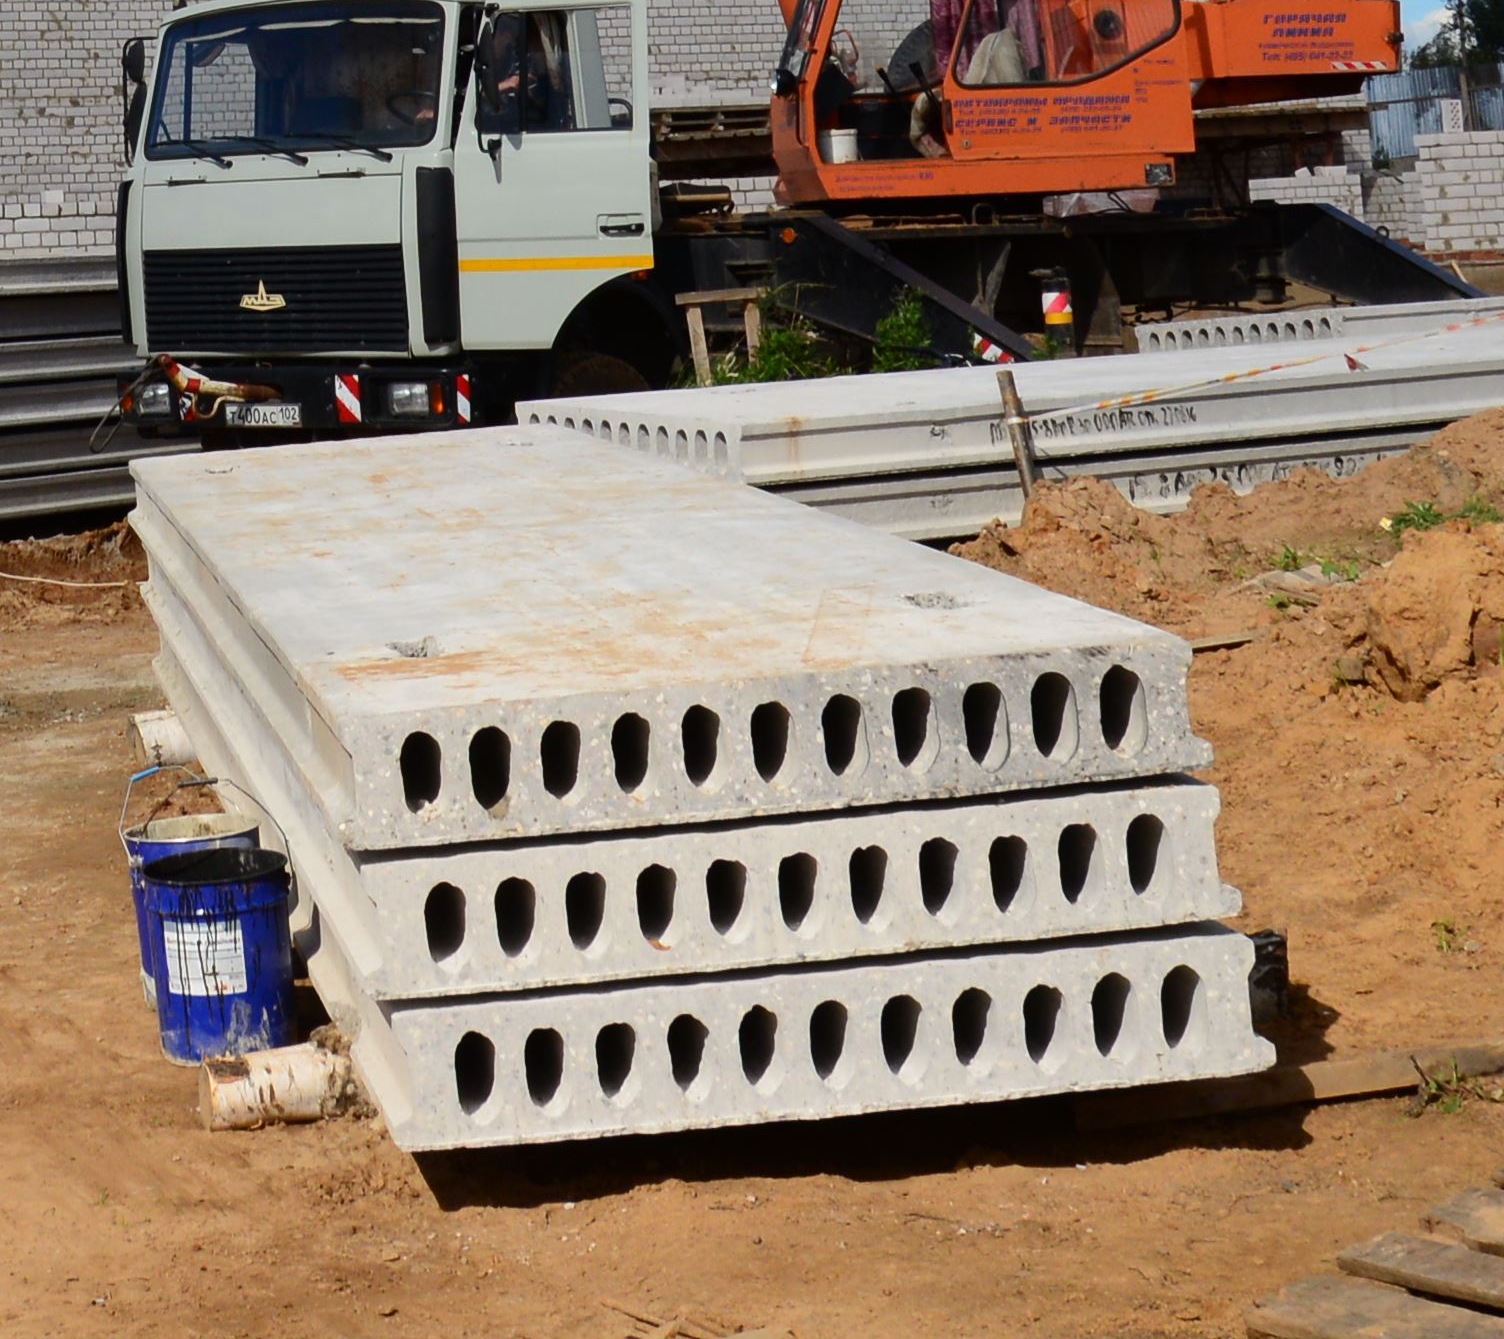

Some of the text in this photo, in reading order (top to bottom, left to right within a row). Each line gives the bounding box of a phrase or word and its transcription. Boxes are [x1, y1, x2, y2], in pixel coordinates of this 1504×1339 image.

[1263, 13, 1347, 24] ГОРЯЧАЯ
[1272, 27, 1334, 37] ЛИНИЯ
[955, 117, 1017, 127] СЕРВИС
[1049, 114, 1132, 125] ЗАПЧАСТИ
[279, 407, 297, 421] 102
